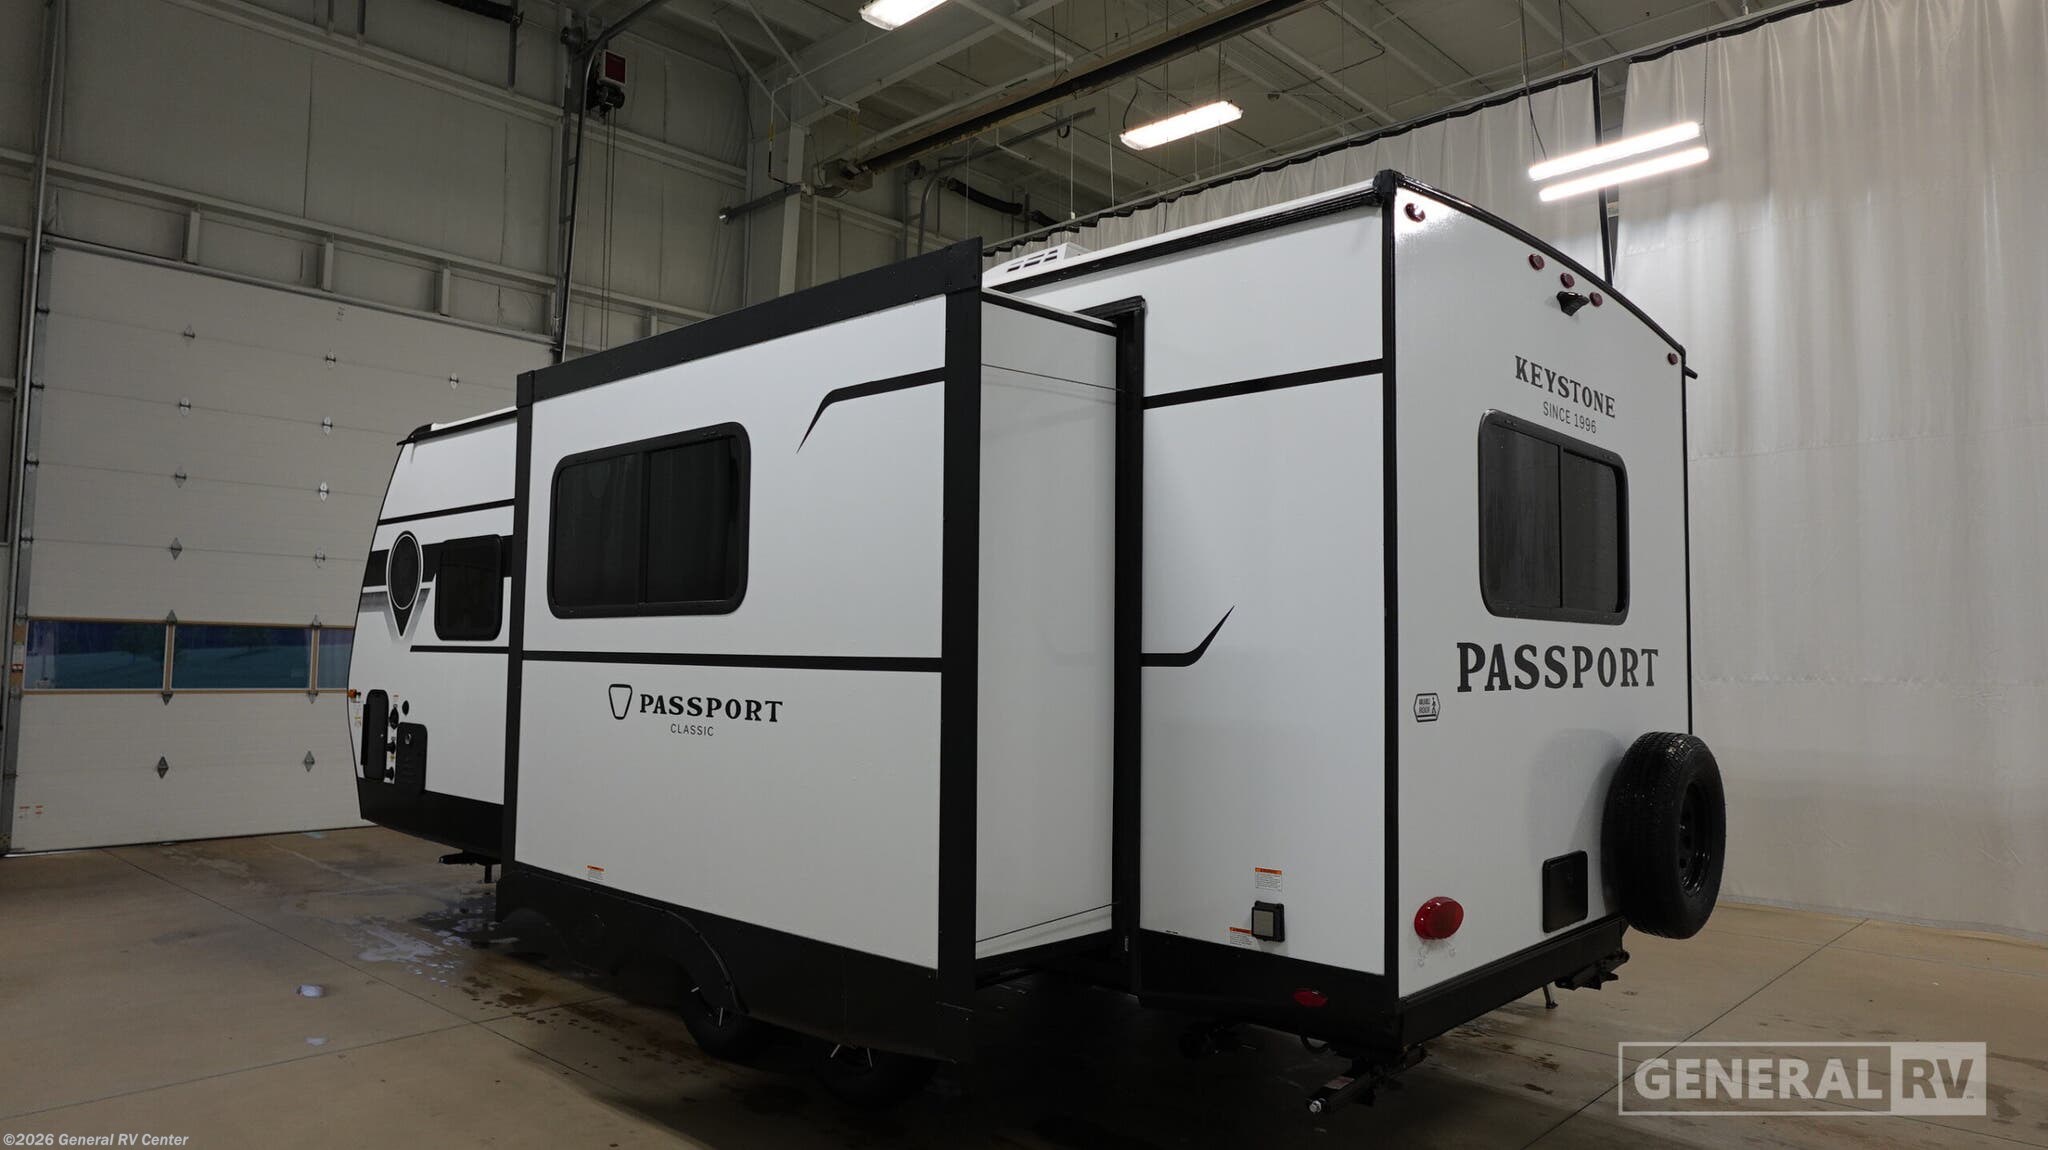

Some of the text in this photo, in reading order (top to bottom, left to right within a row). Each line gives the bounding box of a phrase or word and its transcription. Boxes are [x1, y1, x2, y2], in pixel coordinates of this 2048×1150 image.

[1514, 354, 1616, 419] KEYSTONE
[1543, 400, 1597, 434] SINCE 1996
[1456, 641, 1659, 693] PASSPORT
[639, 692, 784, 723] PASSPORT
[670, 722, 714, 737] CLASSIC
